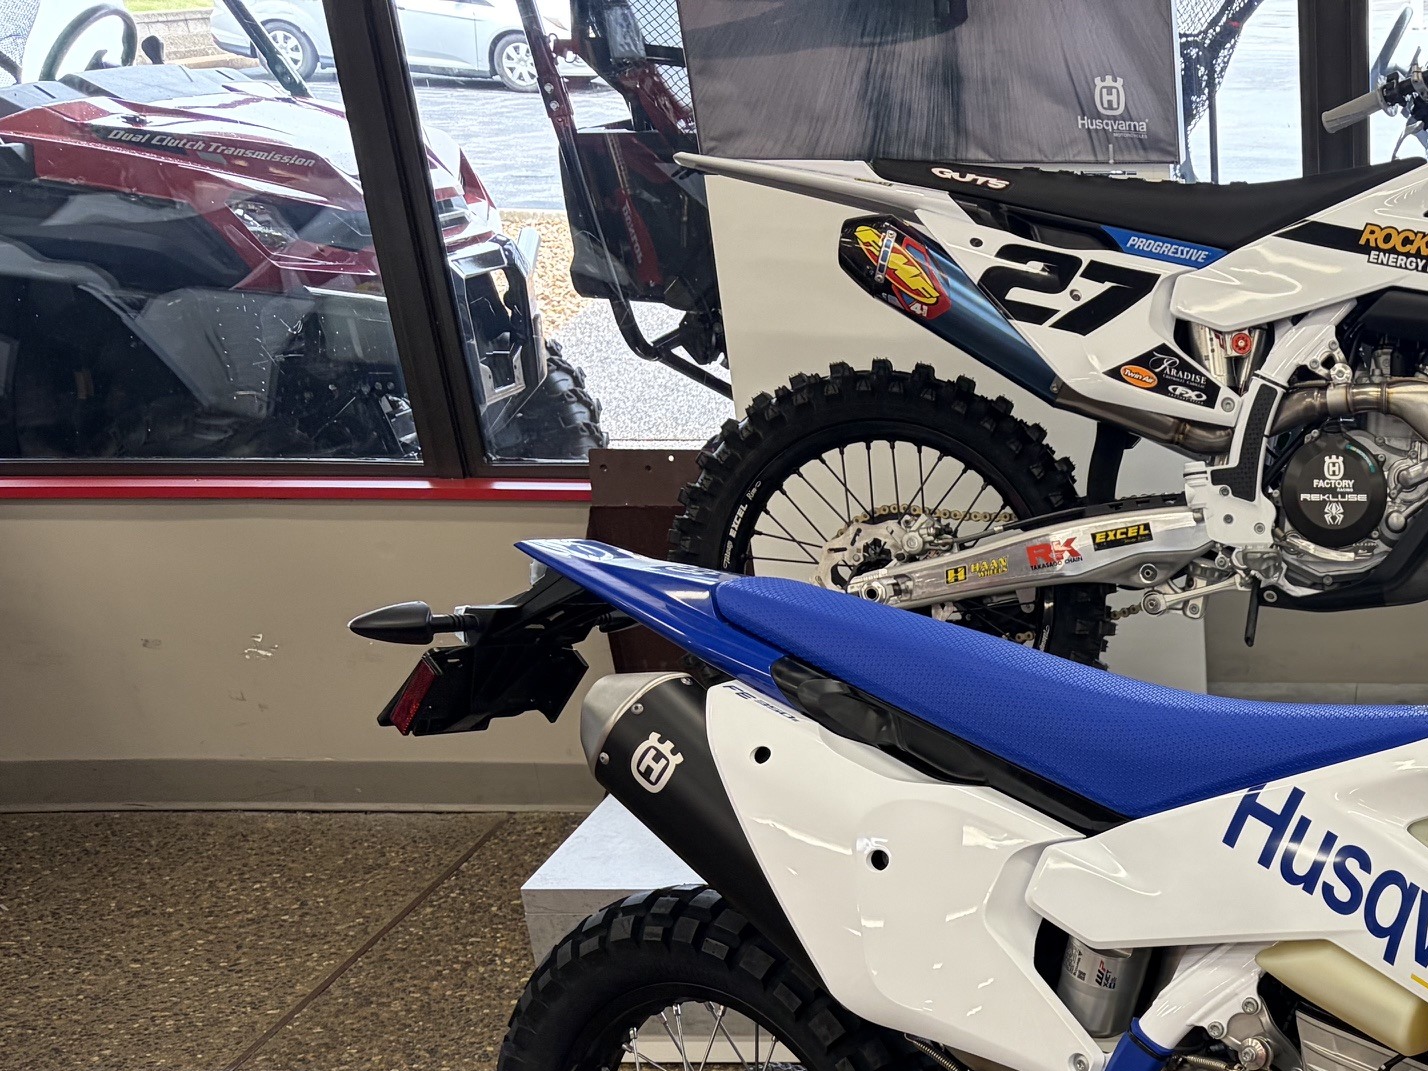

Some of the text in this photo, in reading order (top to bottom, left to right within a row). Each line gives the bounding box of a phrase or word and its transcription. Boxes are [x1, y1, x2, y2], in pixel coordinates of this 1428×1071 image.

[1077, 115, 1148, 132] Husqvarna
[108, 129, 316, 168] Dual Clutch Transmission
[930, 167, 1010, 190] GUTS
[1126, 236, 1209, 263] PROGRESSIVE
[1368, 251, 1426, 271] ENERGY
[978, 243, 1162, 337] 27
[1124, 369, 1155, 384] Twin Air
[1313, 479, 1355, 488] FACTORY
[1300, 493, 1368, 502] REKLUSE
[728, 503, 749, 539] EXCEL
[1094, 524, 1151, 544] EXCEL
[1025, 536, 1083, 567] RK
[971, 555, 1008, 573] HAAN
[1030, 555, 1084, 571] TAKASAGO CHAIN
[722, 685, 757, 699] FE
